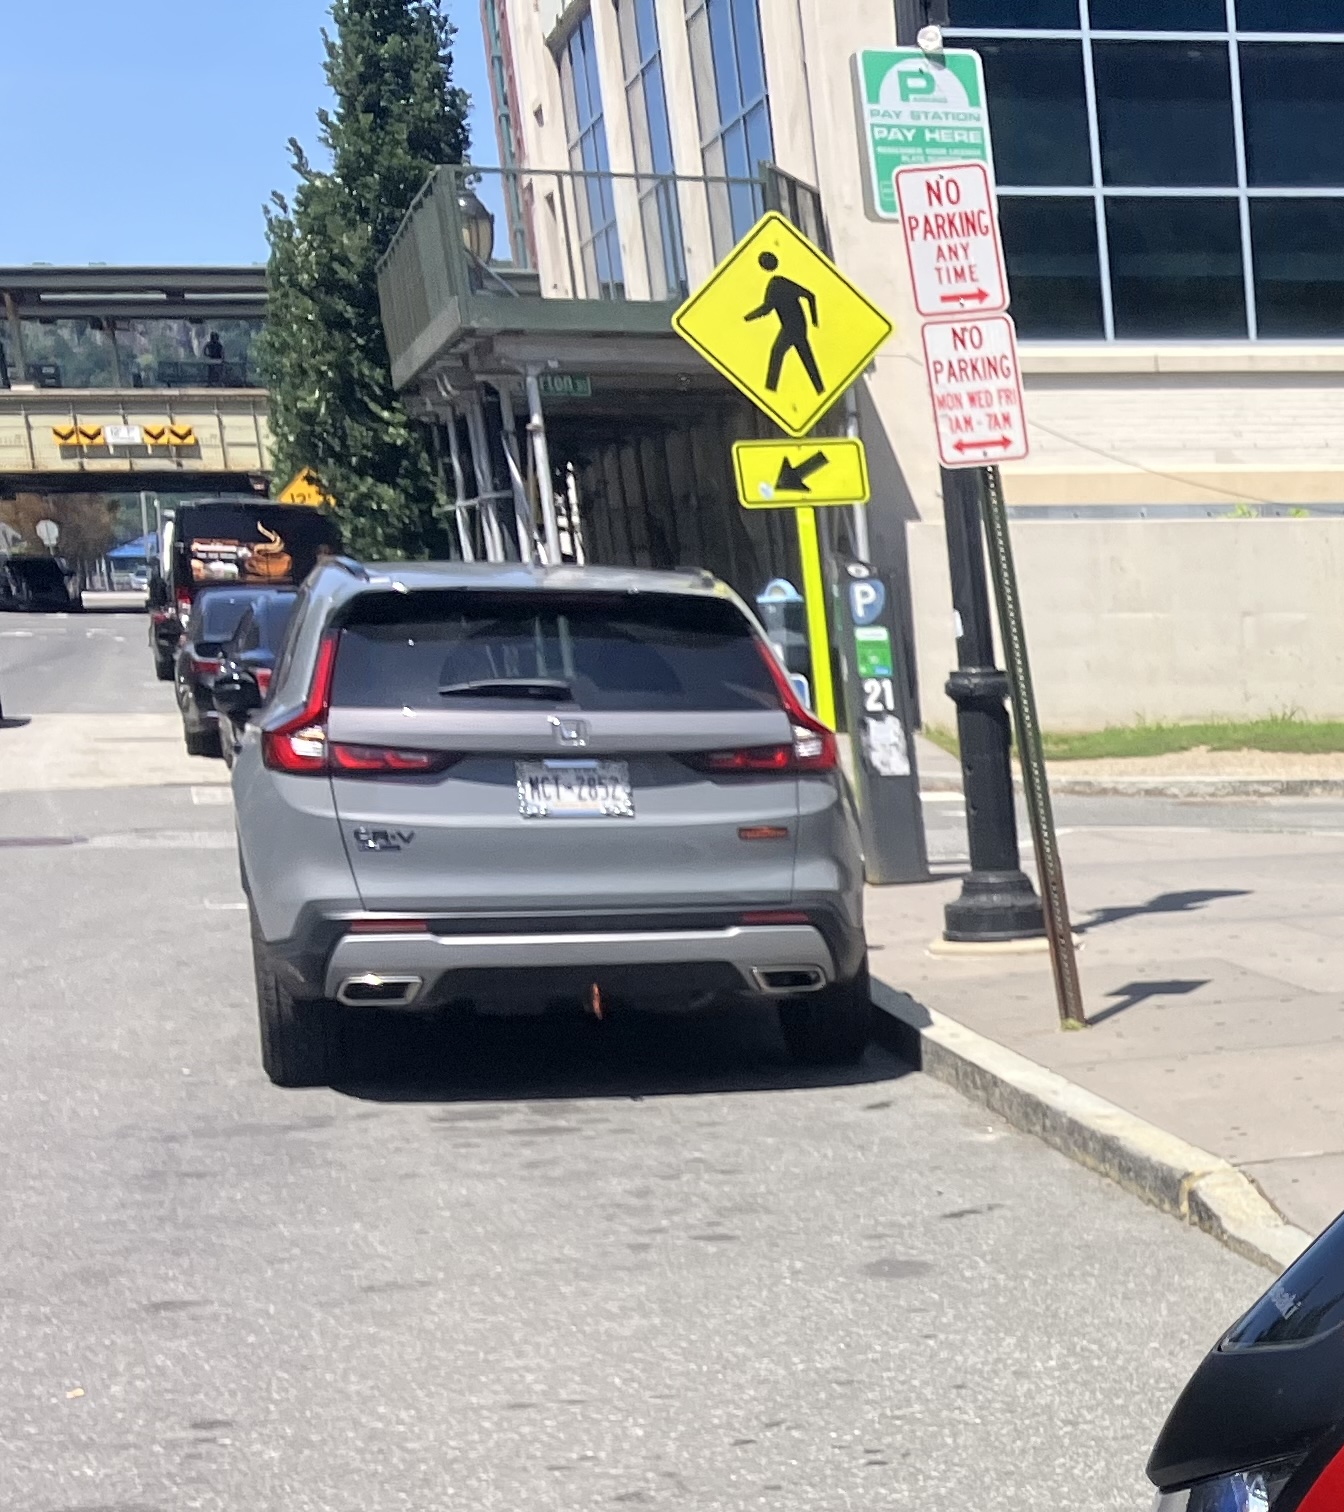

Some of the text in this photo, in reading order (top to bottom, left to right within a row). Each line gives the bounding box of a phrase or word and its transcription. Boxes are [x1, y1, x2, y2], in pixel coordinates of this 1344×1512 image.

[870, 109, 981, 122] PAY STATION
[873, 127, 983, 144] PAY HERE
[926, 178, 960, 207] NO
[908, 209, 990, 241] PARKING
[936, 242, 970, 262] ANY
[935, 264, 979, 285] TIME
[951, 325, 983, 351] NO
[932, 354, 1012, 385] PARKING
[936, 387, 1017, 411] MON WED FRI
[863, 678, 895, 712] 21
